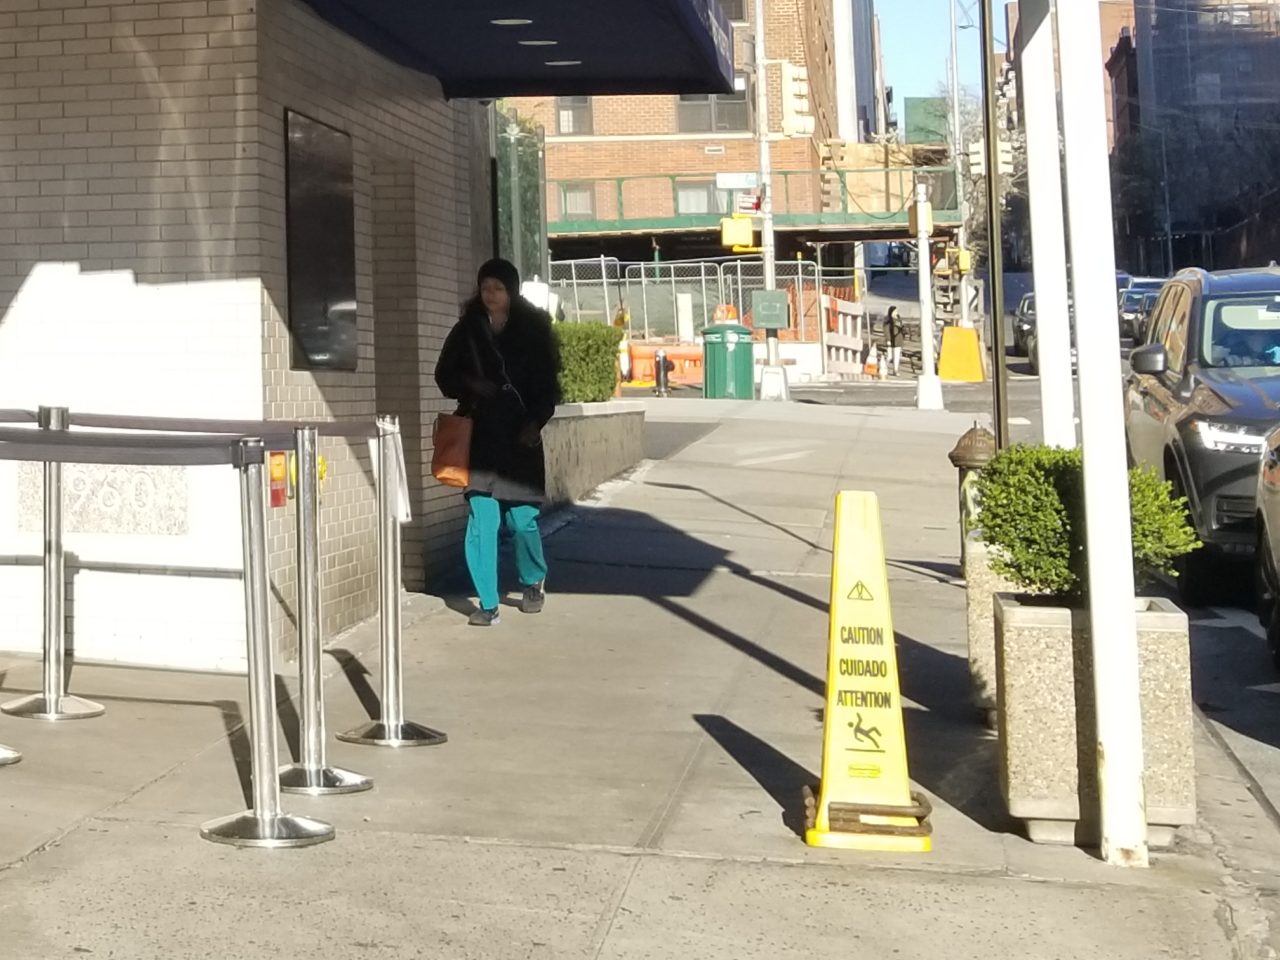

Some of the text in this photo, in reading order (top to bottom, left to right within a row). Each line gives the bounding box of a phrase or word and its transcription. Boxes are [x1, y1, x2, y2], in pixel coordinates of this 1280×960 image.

[840, 626, 884, 646] CAUTION
[839, 659, 887, 678] CUIDADO
[836, 690, 892, 709] ATTENTION
